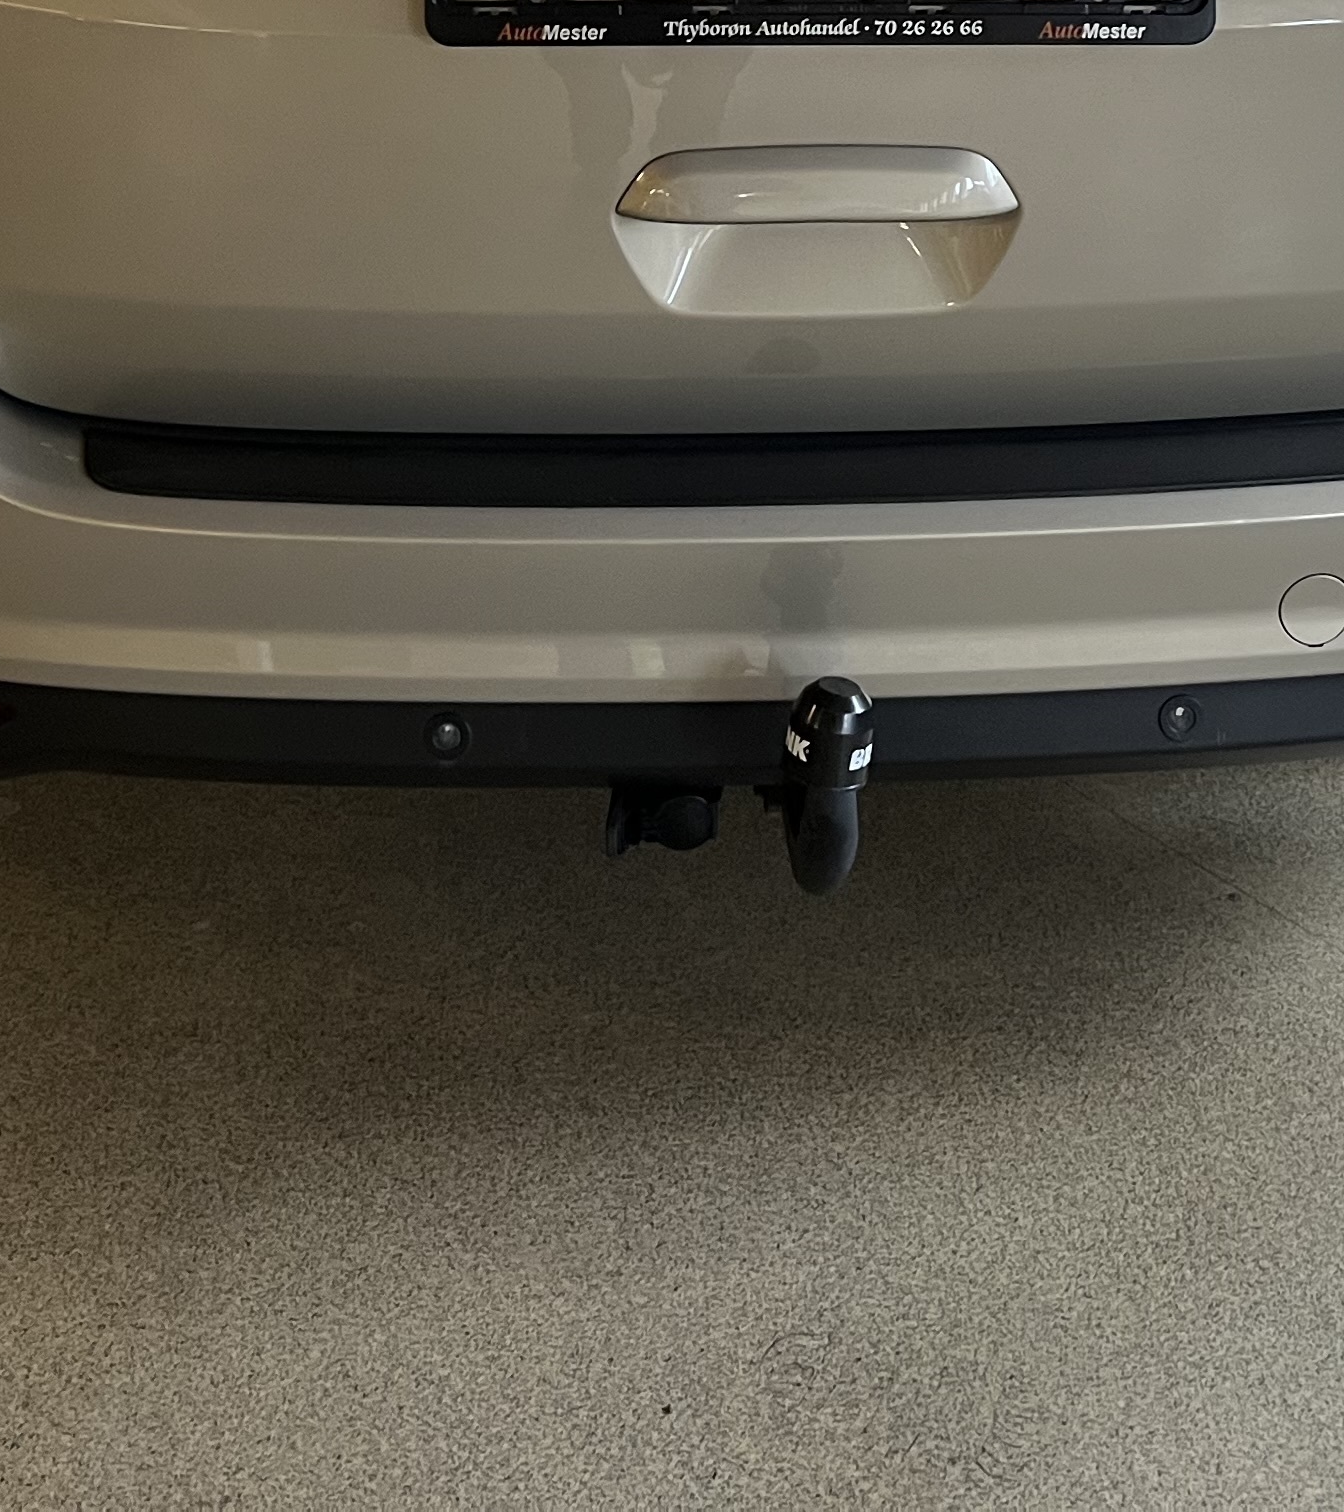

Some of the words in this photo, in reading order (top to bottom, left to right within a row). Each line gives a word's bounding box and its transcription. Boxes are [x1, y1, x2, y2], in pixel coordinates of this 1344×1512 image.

[663, 18, 752, 43] Thyborøn
[755, 17, 862, 36] Autohandel
[874, 19, 898, 36] 70
[902, 19, 926, 36] 26
[930, 19, 955, 36] 26
[959, 19, 984, 36] 66
